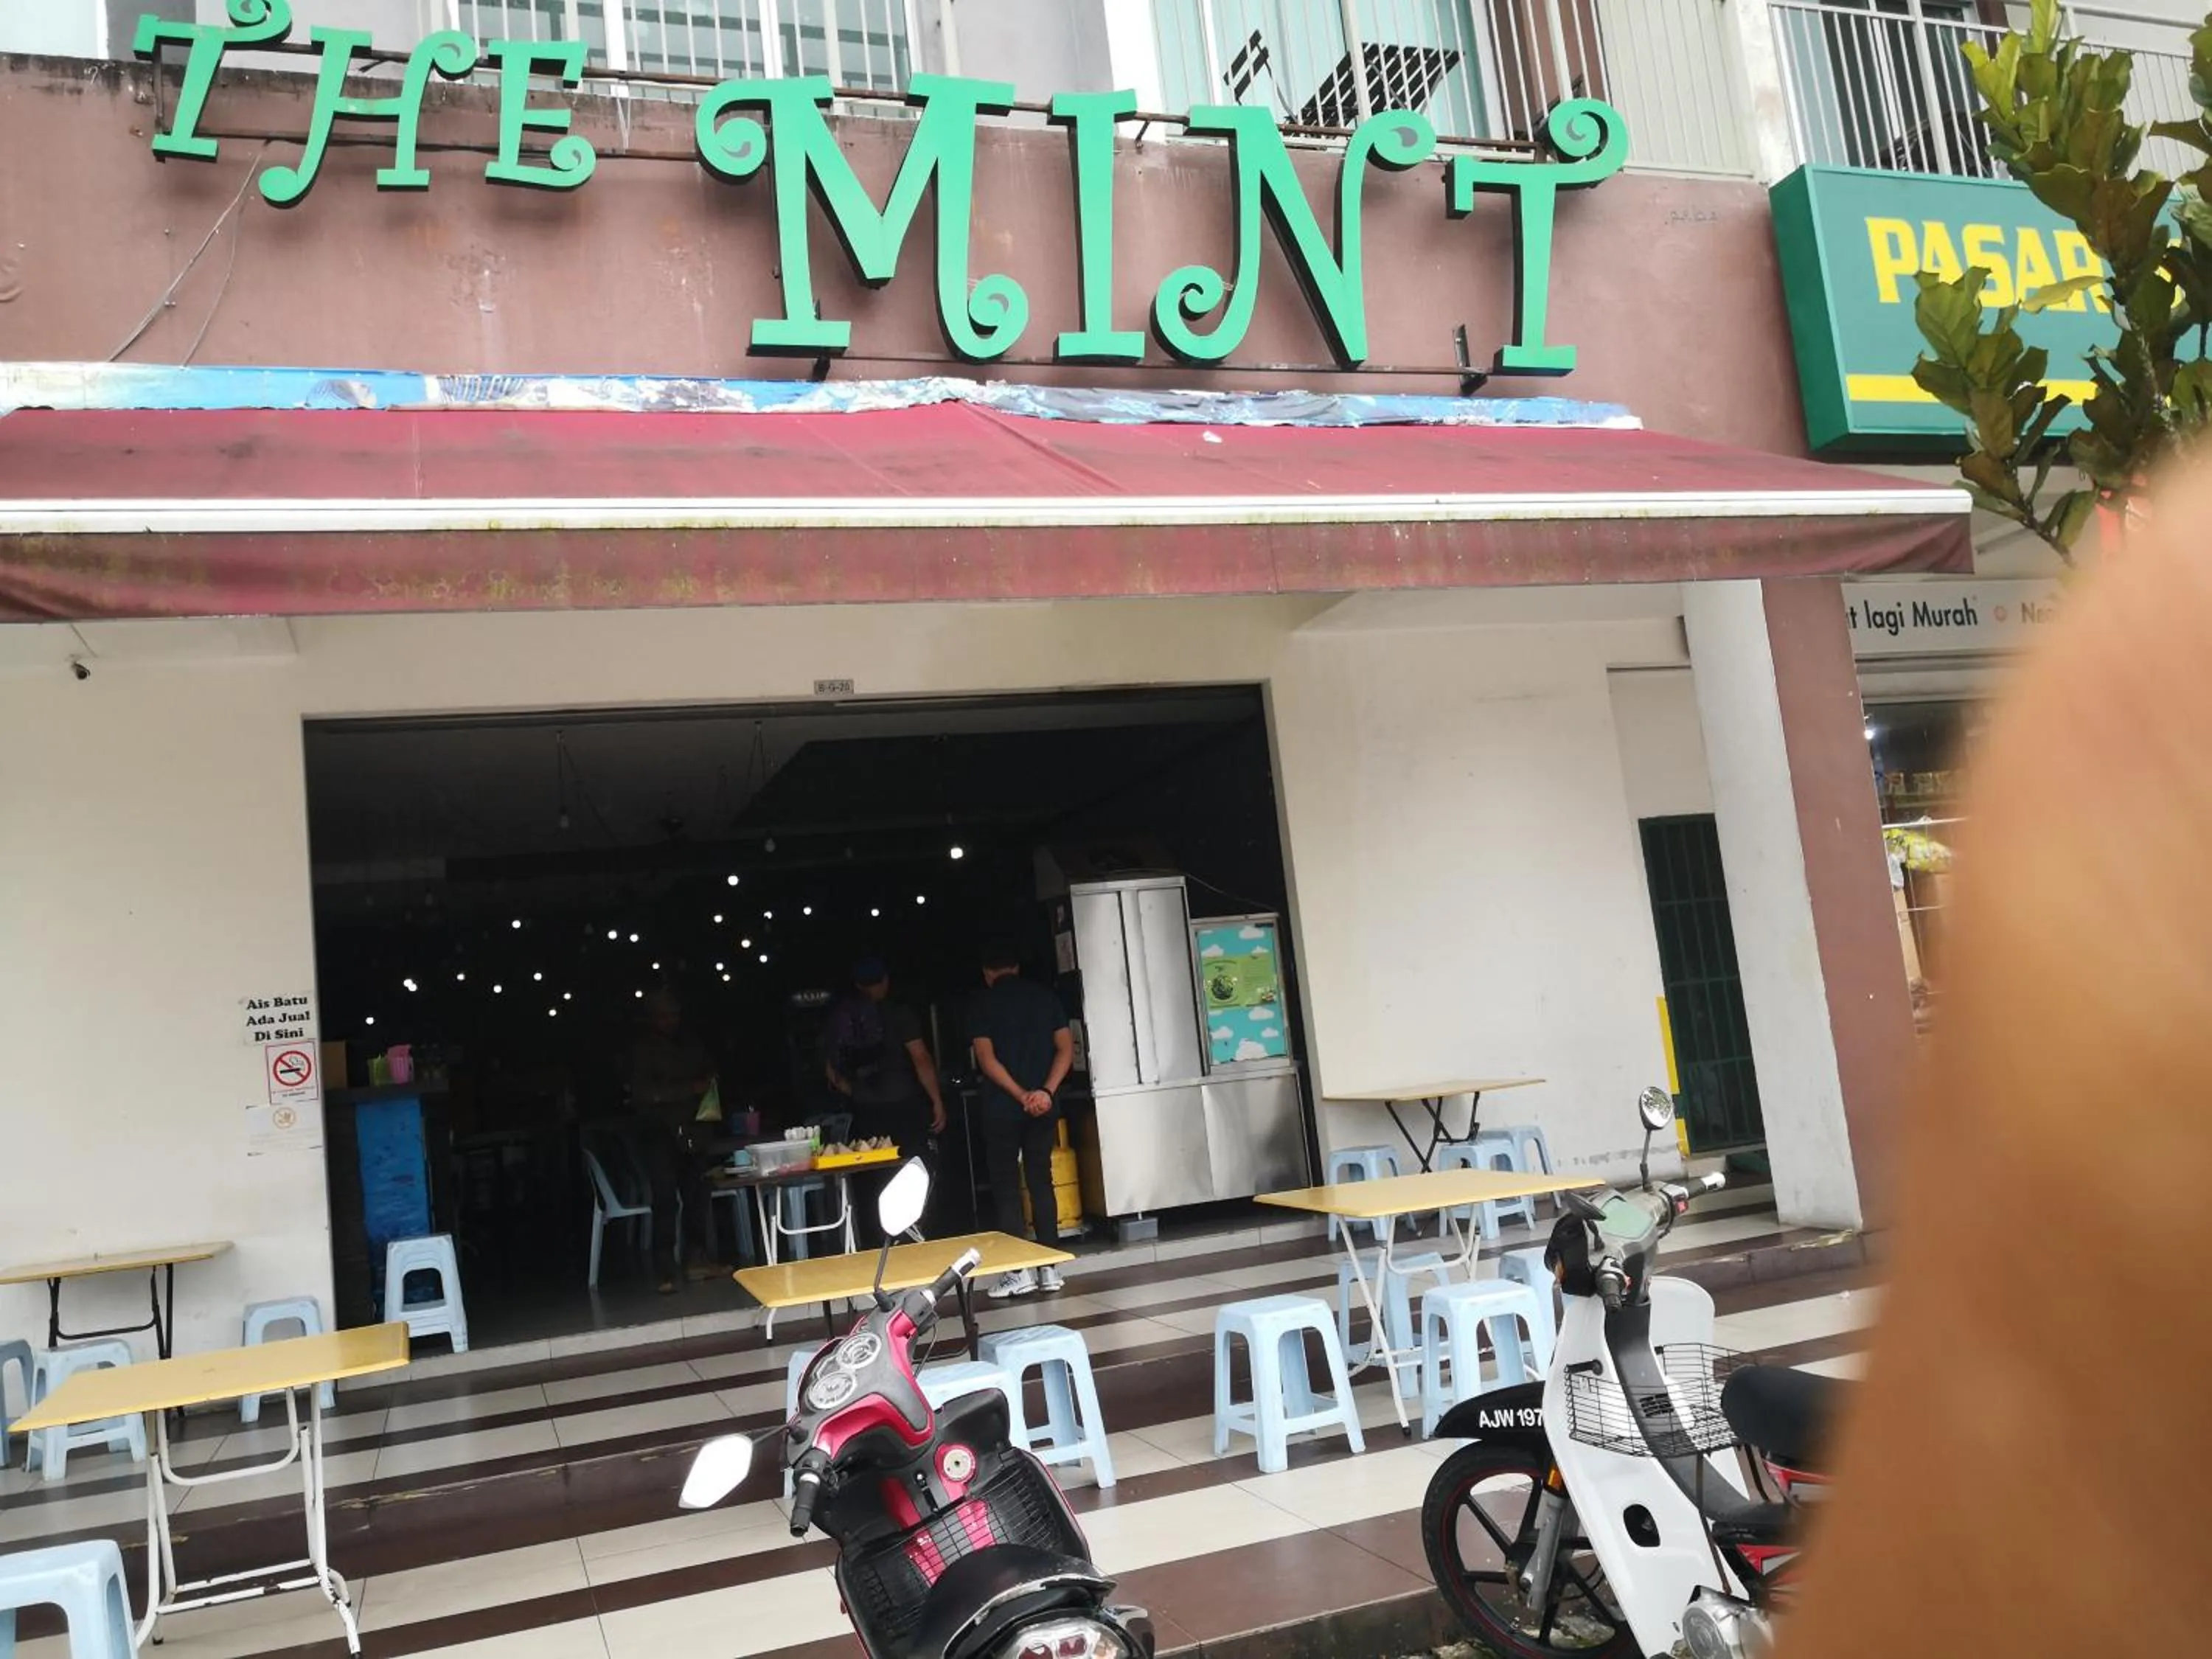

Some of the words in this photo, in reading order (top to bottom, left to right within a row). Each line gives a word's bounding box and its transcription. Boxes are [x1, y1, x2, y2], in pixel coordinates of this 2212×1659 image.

[133, 0, 597, 208] THE
[696, 74, 1629, 375] MINT
[1865, 216, 2111, 314] PASAR
[1864, 599, 1905, 636] lagi
[1913, 598, 1978, 627] Murah
[247, 998, 270, 1010] Ais
[274, 996, 307, 1008] Batu
[246, 1015, 275, 1026] Ada
[279, 1011, 310, 1023] Jual
[254, 1031, 271, 1041] Di
[274, 1028, 305, 1040] Sini
[1479, 1409, 1513, 1428] AJW
